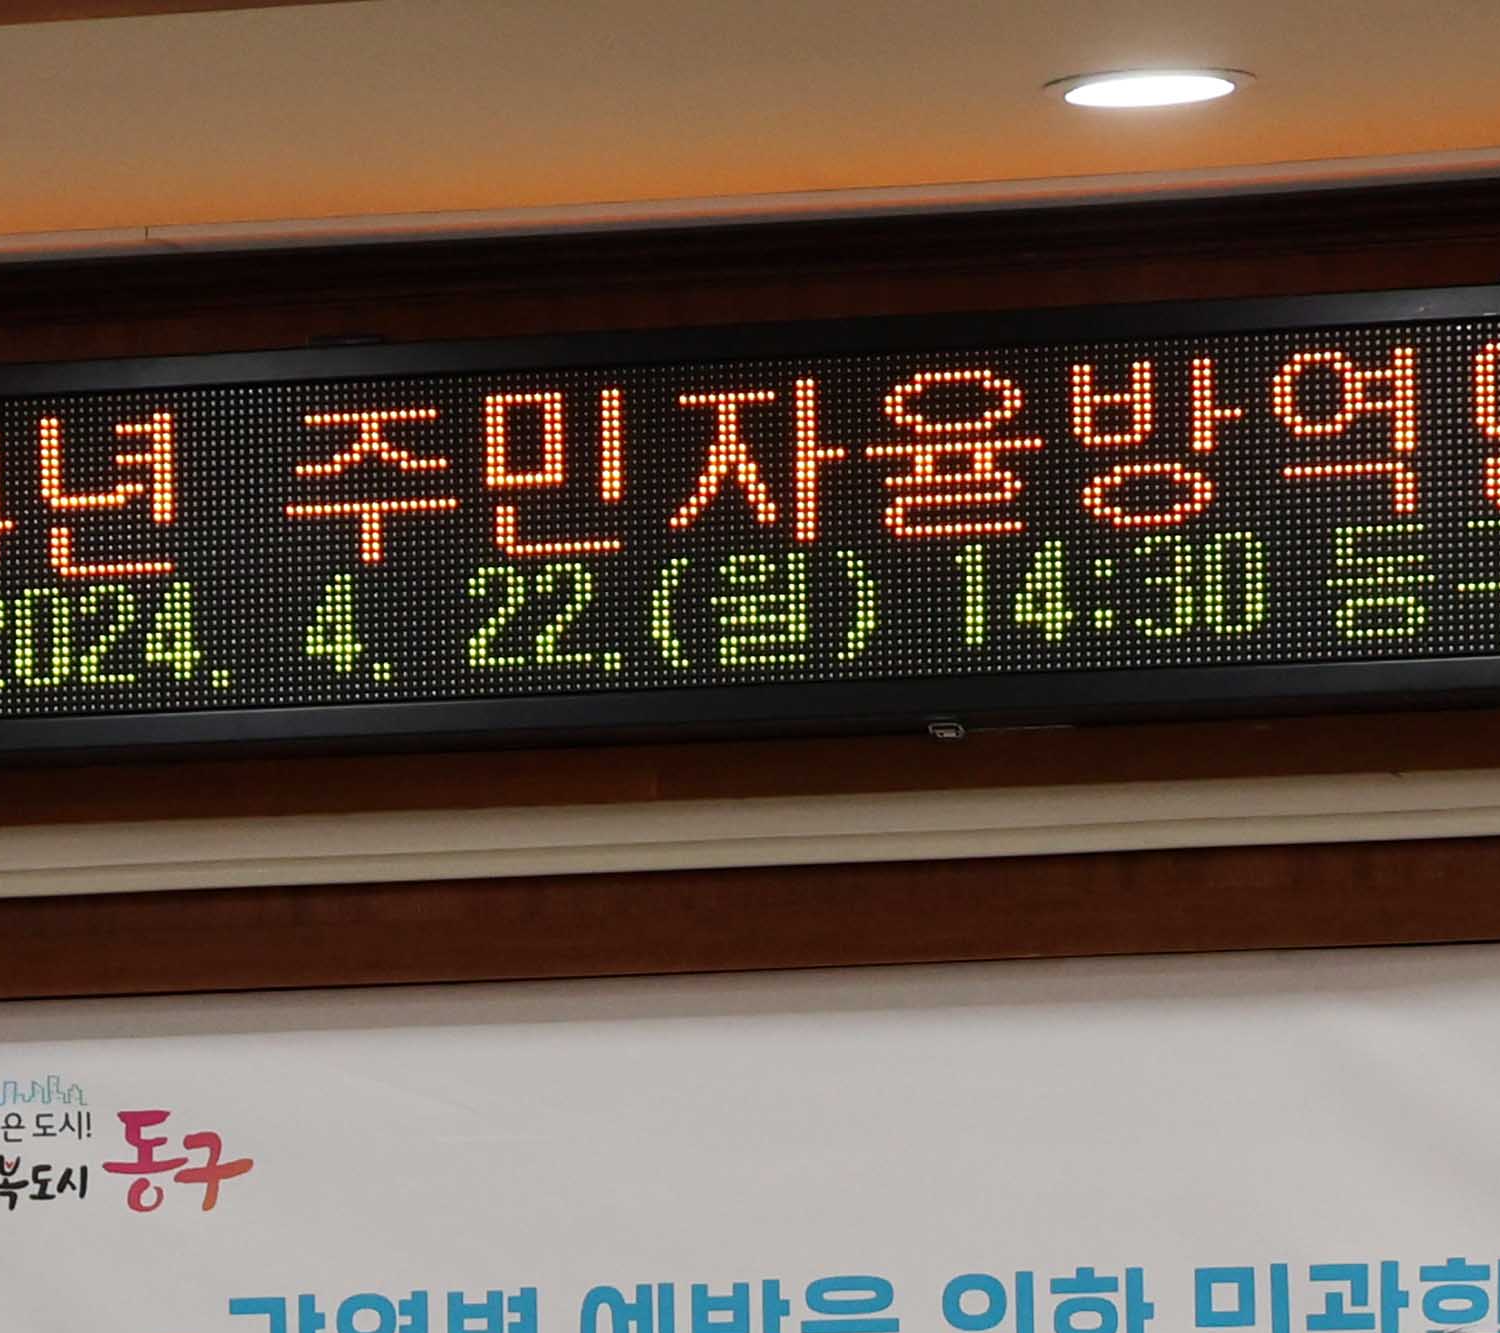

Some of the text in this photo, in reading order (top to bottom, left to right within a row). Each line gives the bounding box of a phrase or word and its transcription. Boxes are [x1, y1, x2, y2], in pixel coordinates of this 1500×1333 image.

[302, 572, 394, 682] 4.
[956, 530, 1266, 648] 14:30
[32, 1111, 93, 1140] 도시!
[102, 1110, 254, 1213] 동구
